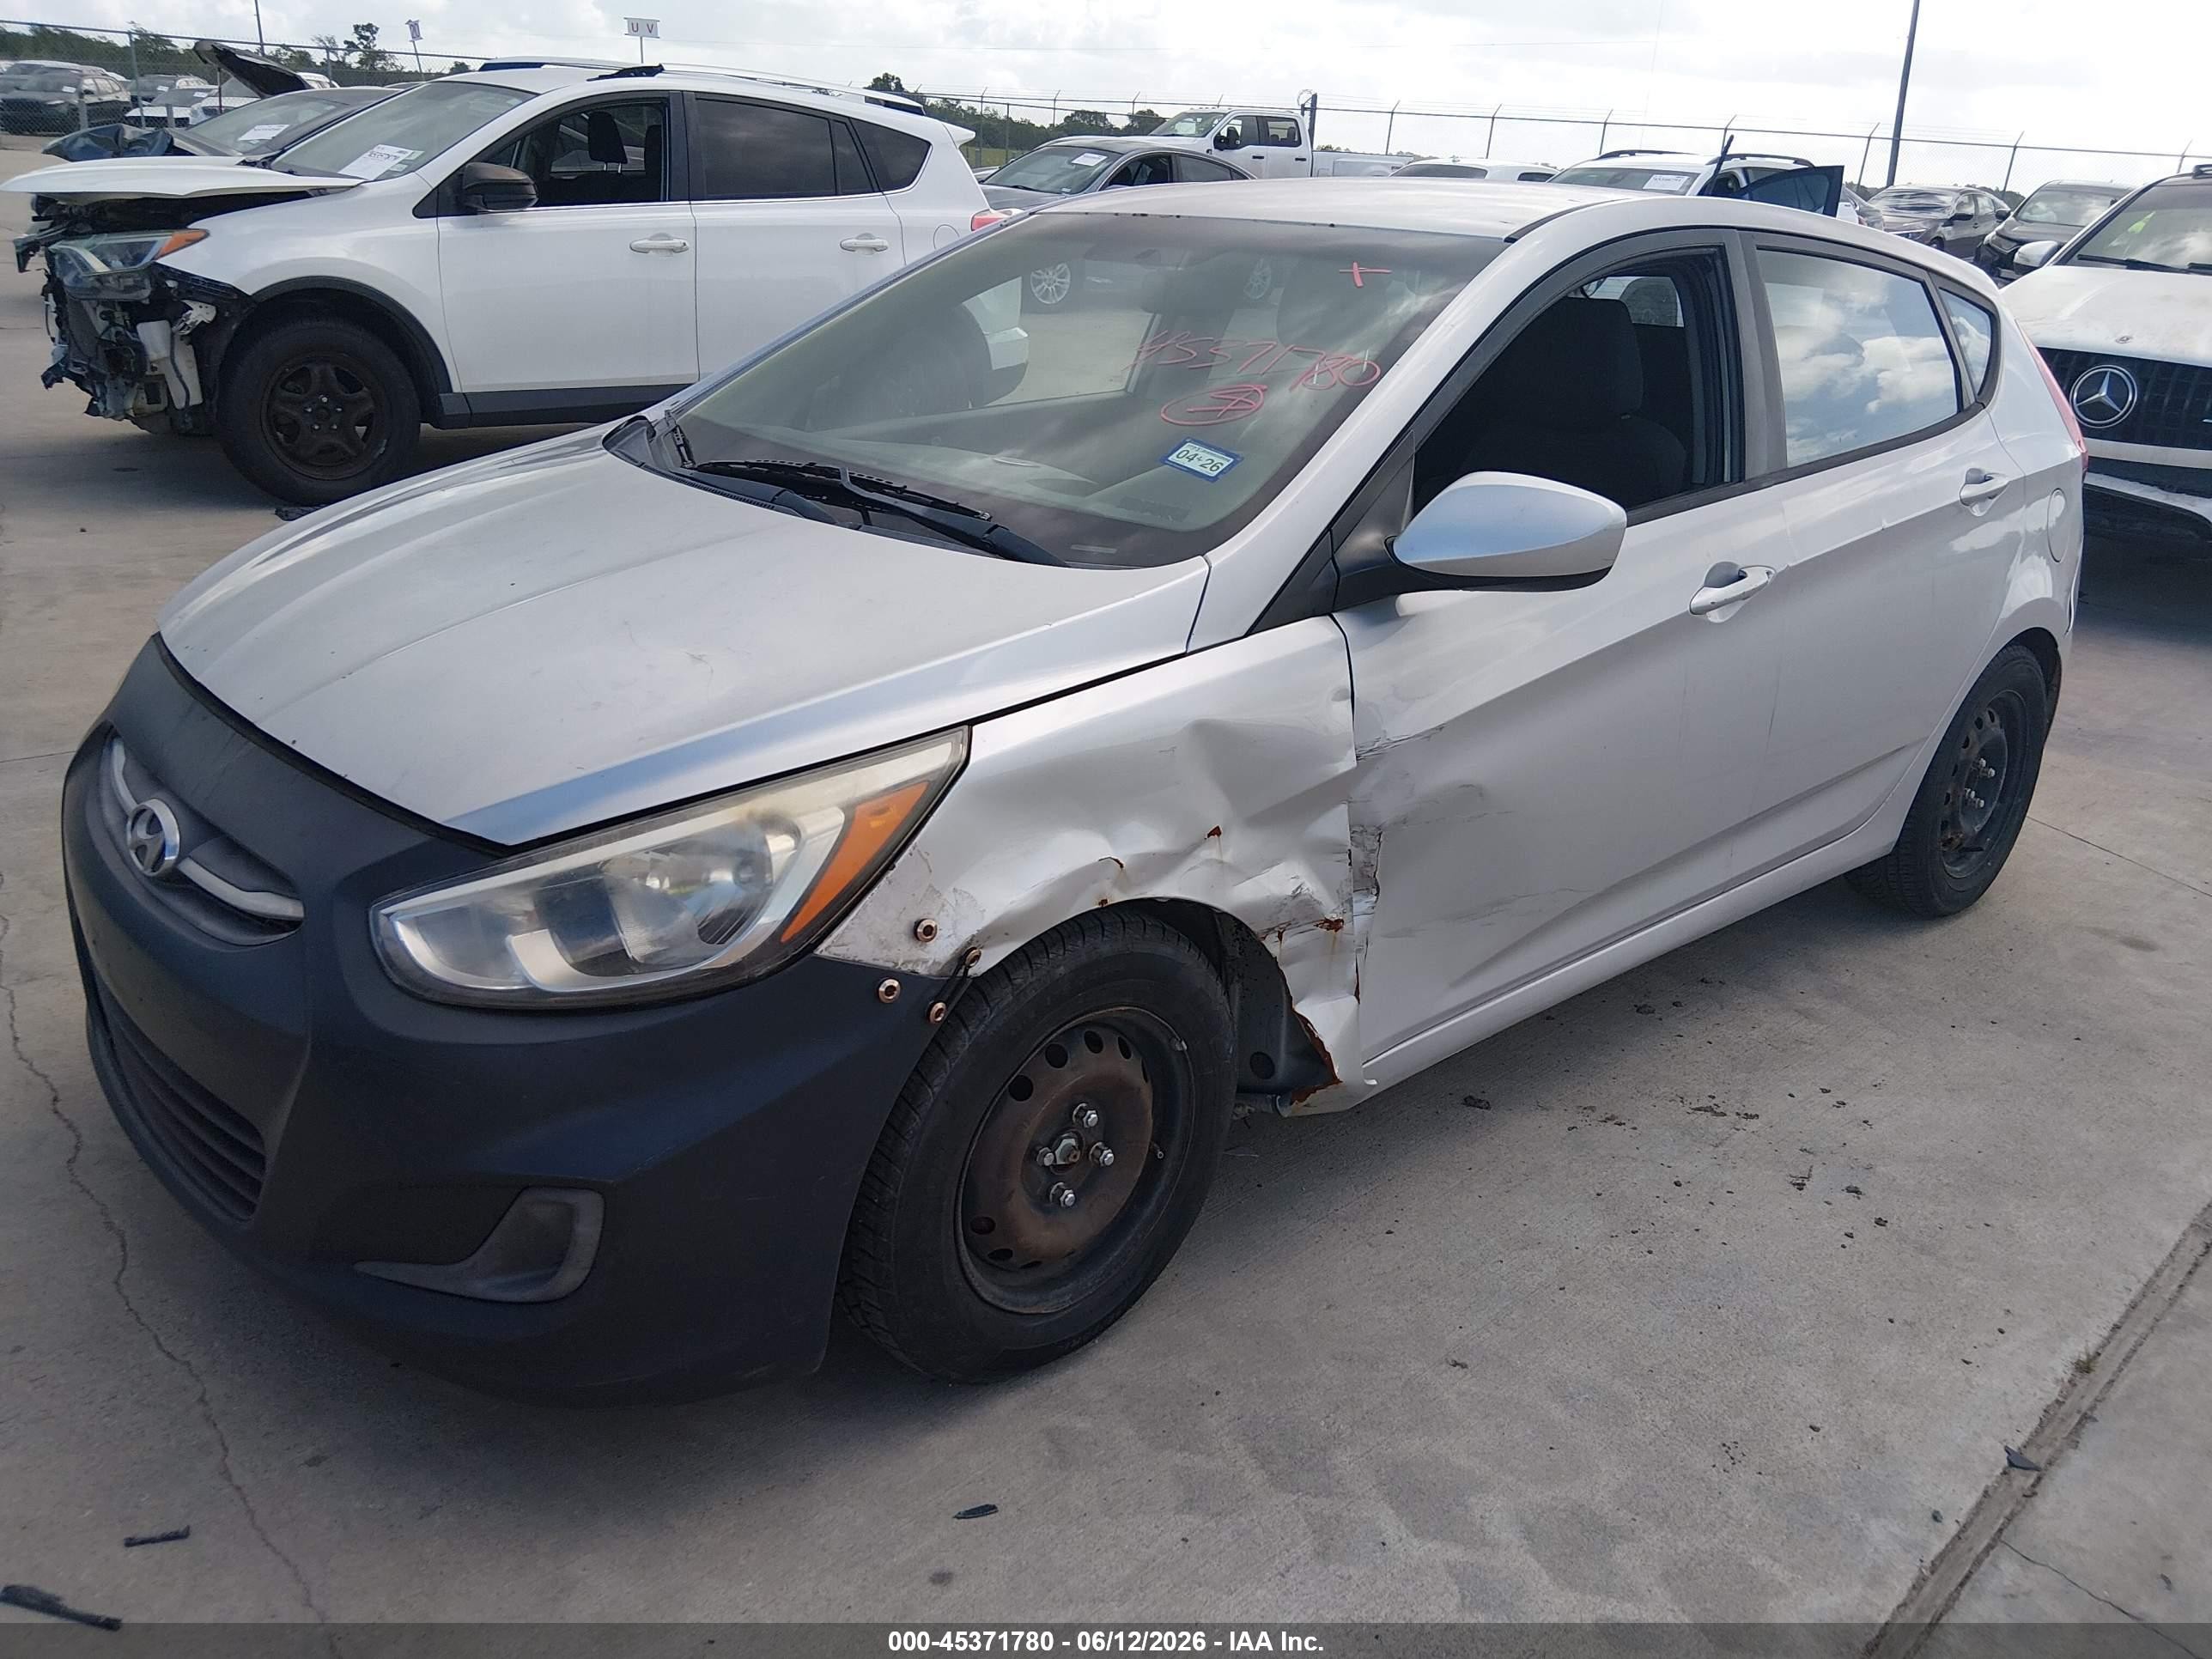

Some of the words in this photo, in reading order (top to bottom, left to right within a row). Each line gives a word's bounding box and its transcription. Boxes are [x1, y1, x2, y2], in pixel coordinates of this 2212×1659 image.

[631, 21, 639, 33] U
[646, 23, 654, 33] V
[1199, 458, 1224, 471] 26
